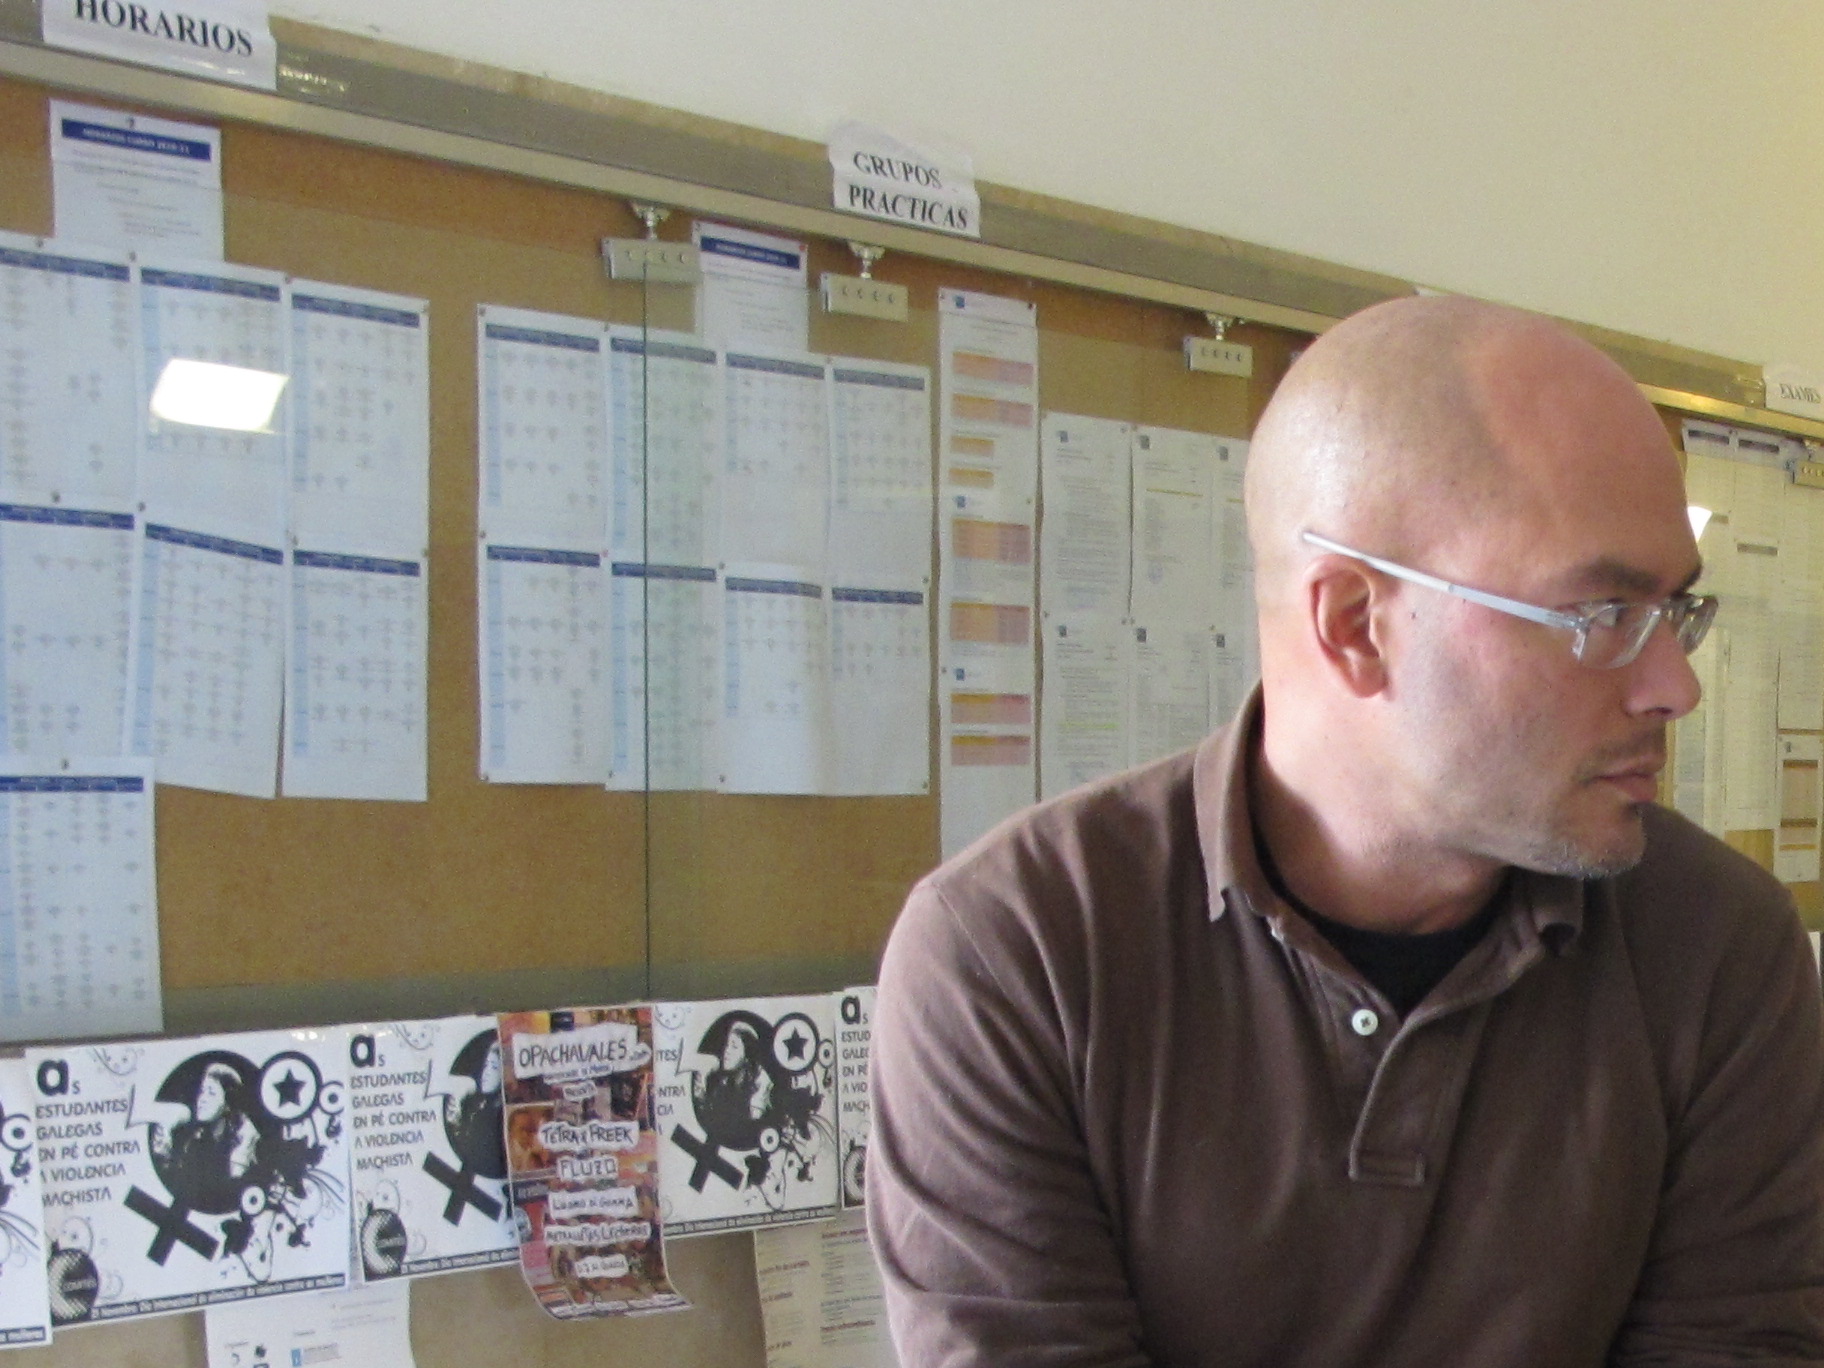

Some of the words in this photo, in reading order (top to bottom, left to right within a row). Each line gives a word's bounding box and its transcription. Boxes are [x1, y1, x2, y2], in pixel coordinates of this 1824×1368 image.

[76, 0, 253, 56] HORARIOS
[853, 151, 942, 189] GRUPOS
[849, 184, 968, 229] PRACTICAS
[350, 1071, 428, 1089] ESTUDANTES
[36, 1099, 128, 1119] ESTUDANTES
[352, 1093, 404, 1109] GALEGAS
[388, 1110, 437, 1125] CONTRA
[37, 1122, 103, 1140] GALEGAS
[365, 1129, 424, 1147] VIOLENCIA
[62, 1142, 79, 1160] PÉ
[85, 1140, 140, 1158] CONTRA
[356, 1152, 413, 1172] MACHISTA
[51, 1163, 126, 1182] VIOLENCIA
[42, 1186, 112, 1208] MACHISTA
